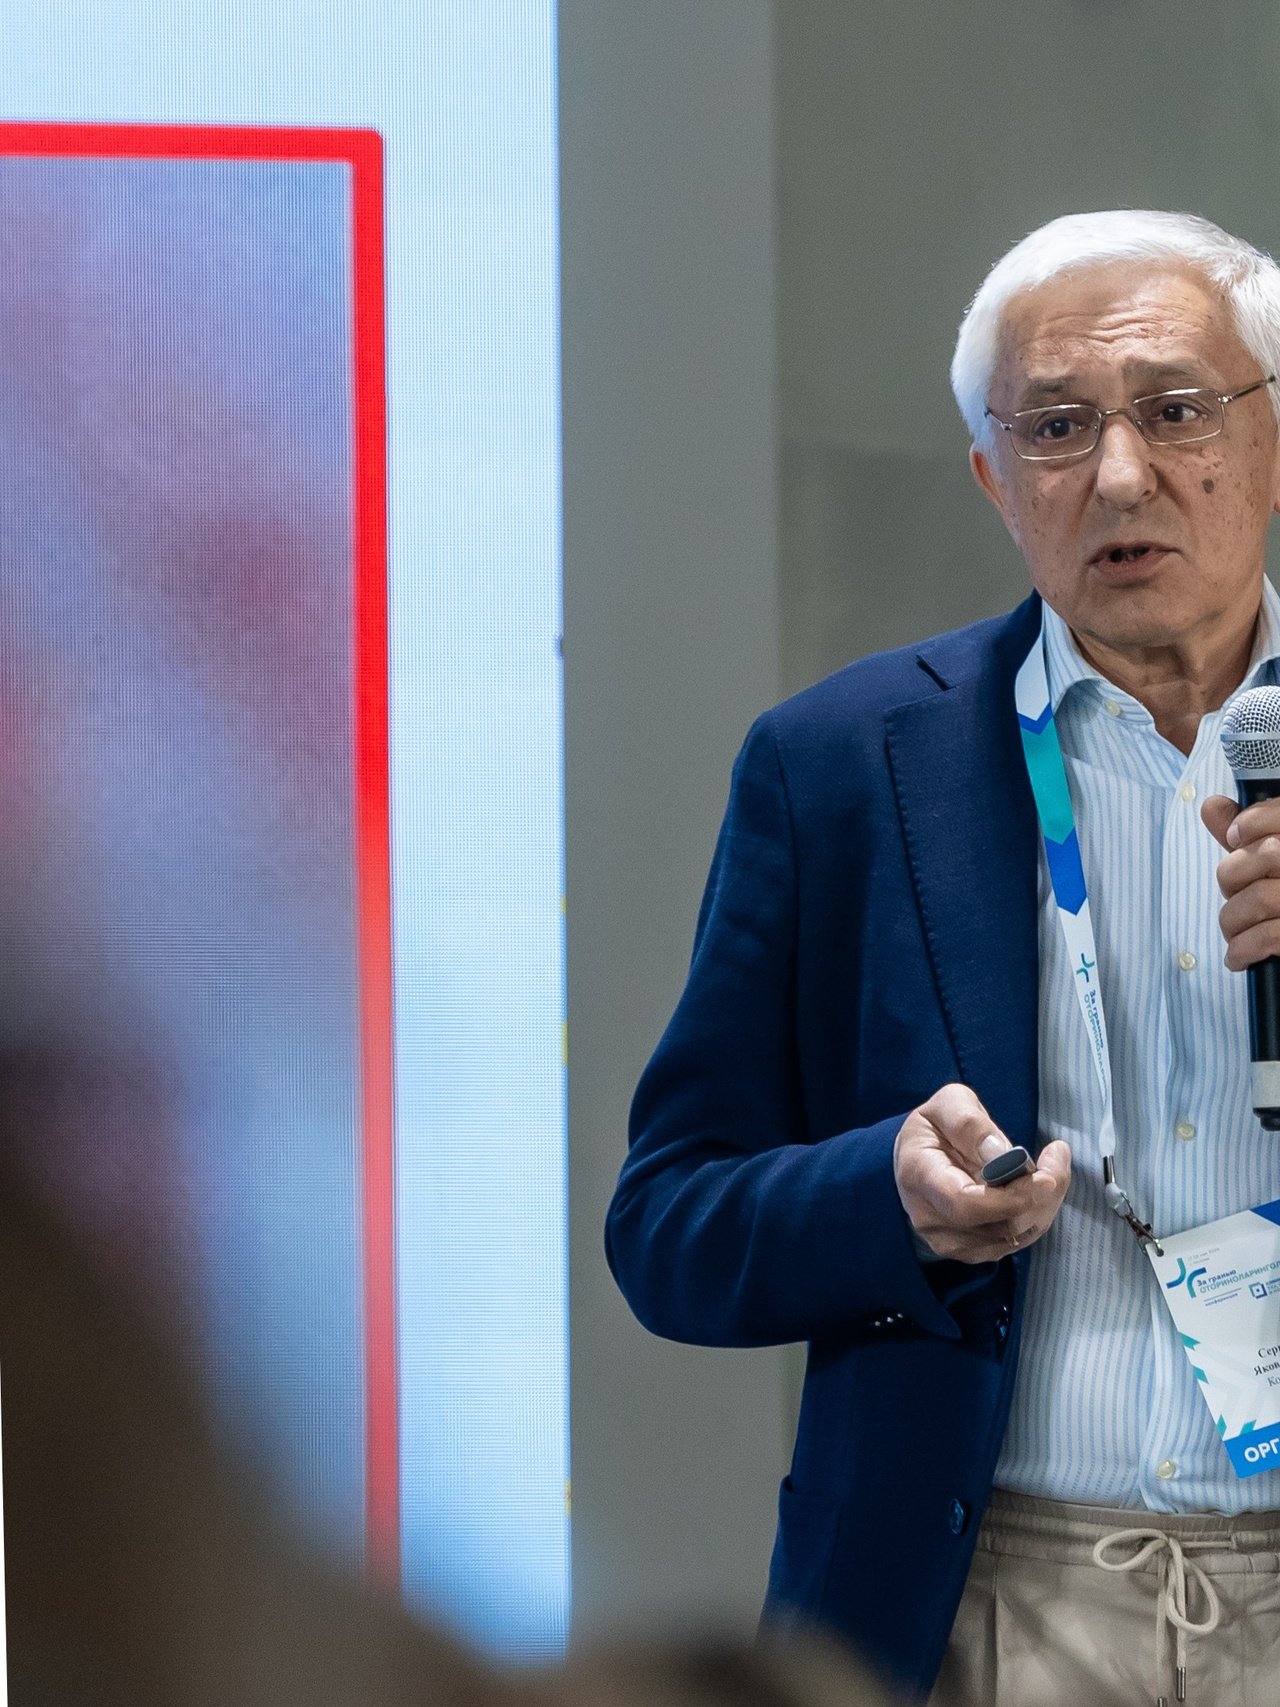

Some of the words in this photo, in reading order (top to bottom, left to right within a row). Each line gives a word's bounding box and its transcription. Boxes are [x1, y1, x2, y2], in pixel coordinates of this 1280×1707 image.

[1090, 990, 1097, 1005] За
[1197, 1279, 1207, 1287] За
[1208, 1269, 1237, 1284] гранью
